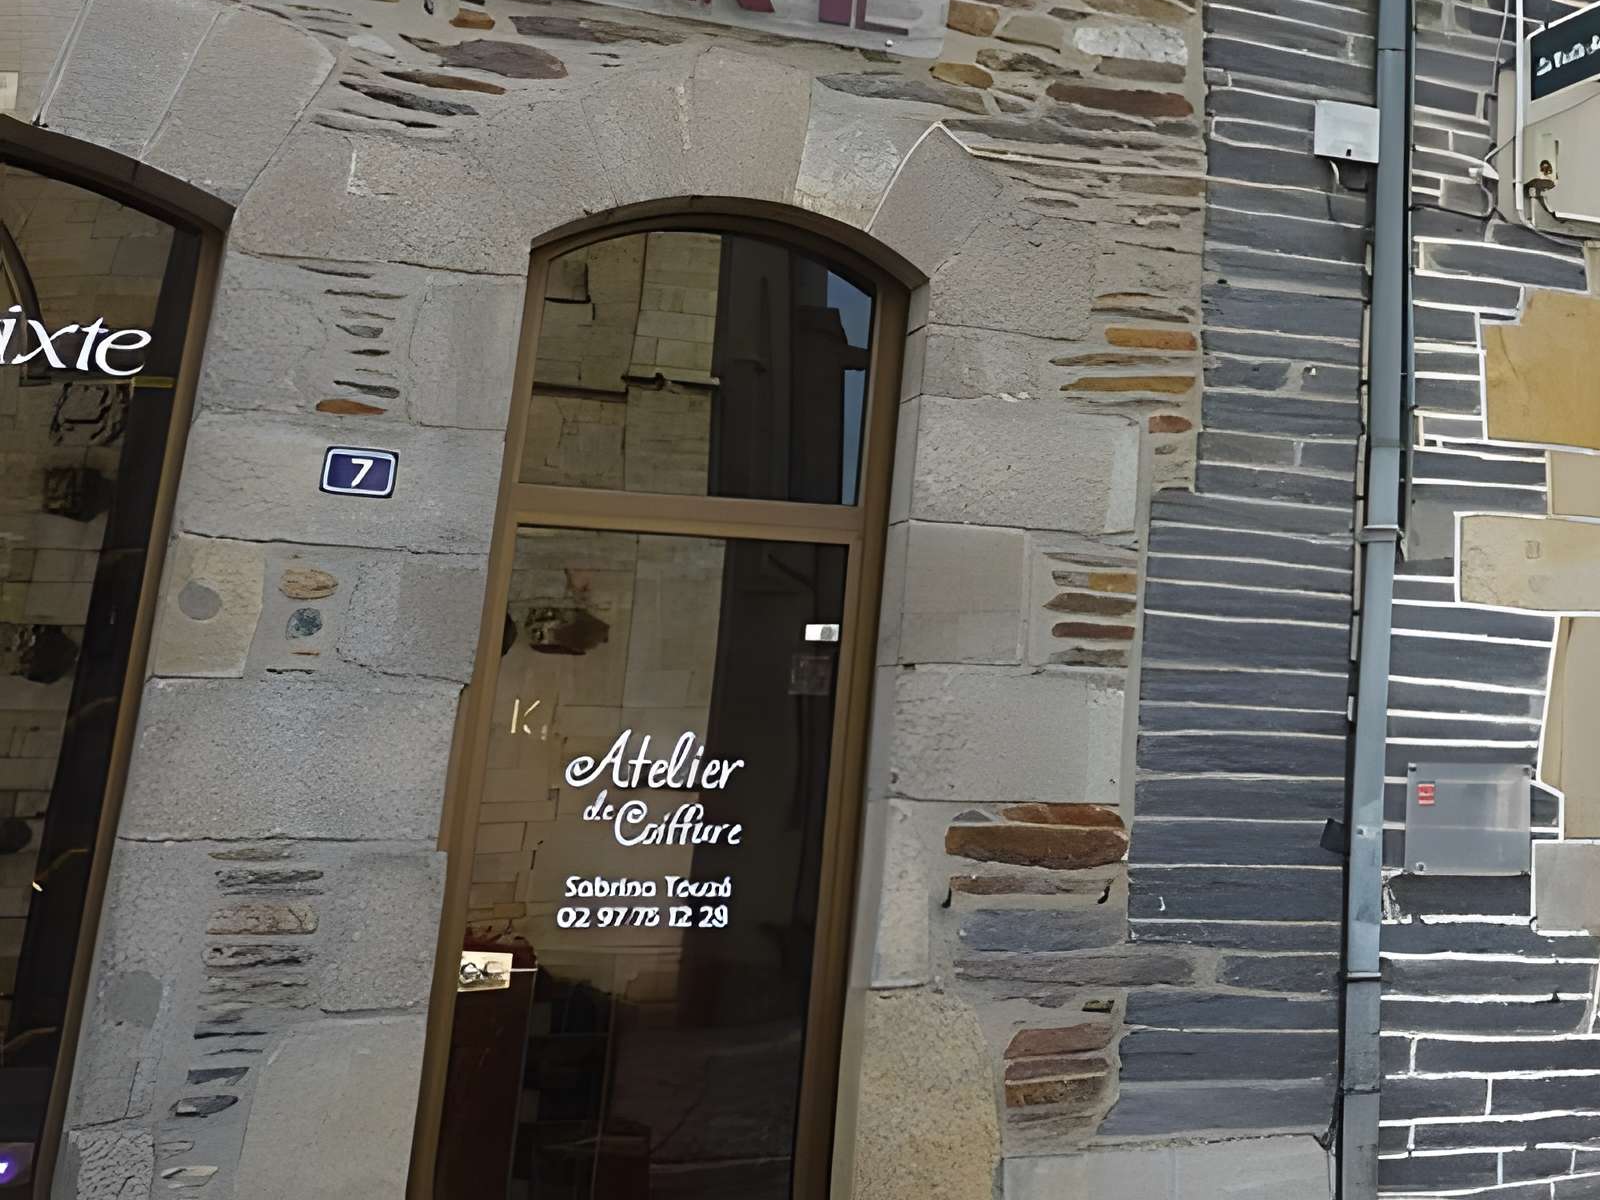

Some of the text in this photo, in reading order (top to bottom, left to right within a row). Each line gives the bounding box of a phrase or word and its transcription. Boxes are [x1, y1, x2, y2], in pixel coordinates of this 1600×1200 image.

[349, 457, 374, 489] 7
[564, 728, 745, 790] Atelier
[583, 789, 743, 847] de Coiffure
[564, 875, 657, 898] Sabrina
[556, 906, 591, 929] 02
[596, 905, 628, 928] 97
[697, 904, 729, 928] 29
